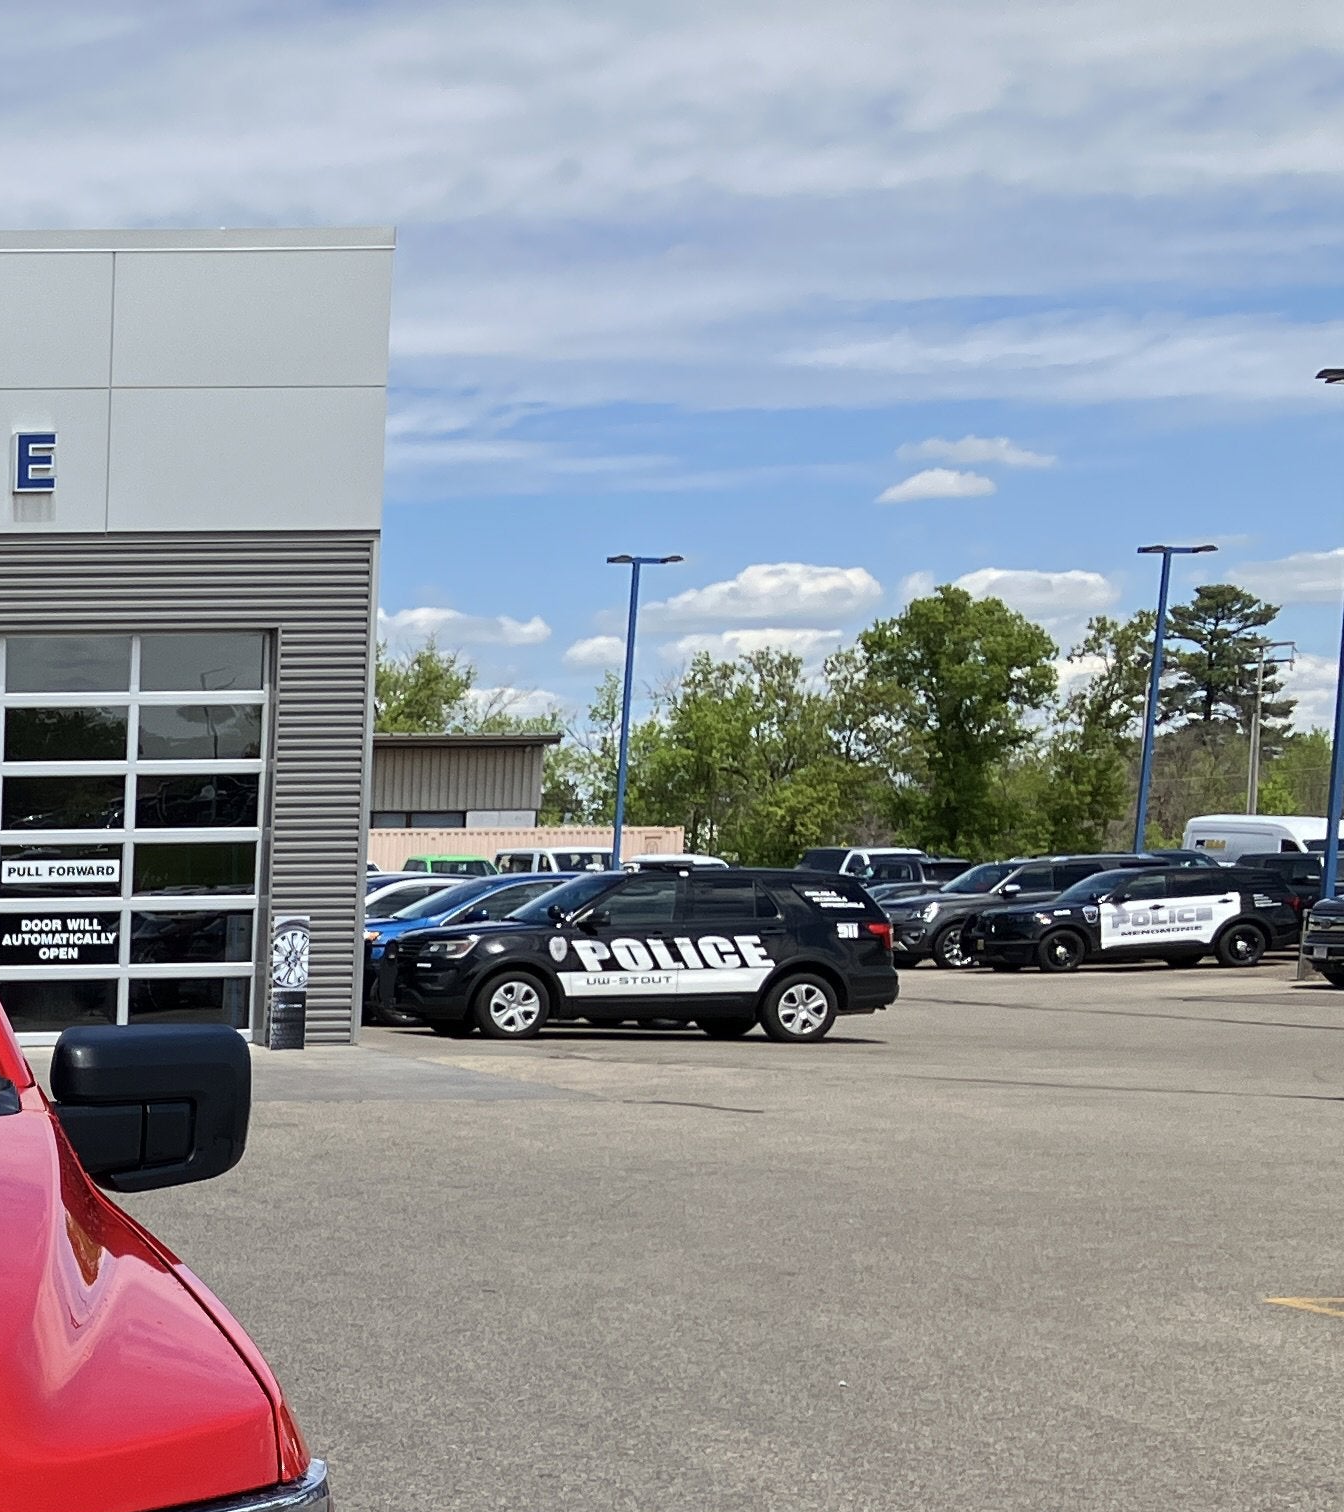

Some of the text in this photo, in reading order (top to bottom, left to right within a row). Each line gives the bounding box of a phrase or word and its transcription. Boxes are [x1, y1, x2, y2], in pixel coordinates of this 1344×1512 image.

[8, 865, 115, 877] PULL FORWARD
[1111, 906, 1214, 929] POLICE
[21, 918, 102, 931] DOOR WILL
[1, 932, 117, 945] AUTOMATICALLY
[38, 947, 79, 960] OPEN
[570, 934, 776, 972] POLICE
[586, 975, 673, 985] UW-STOUT
